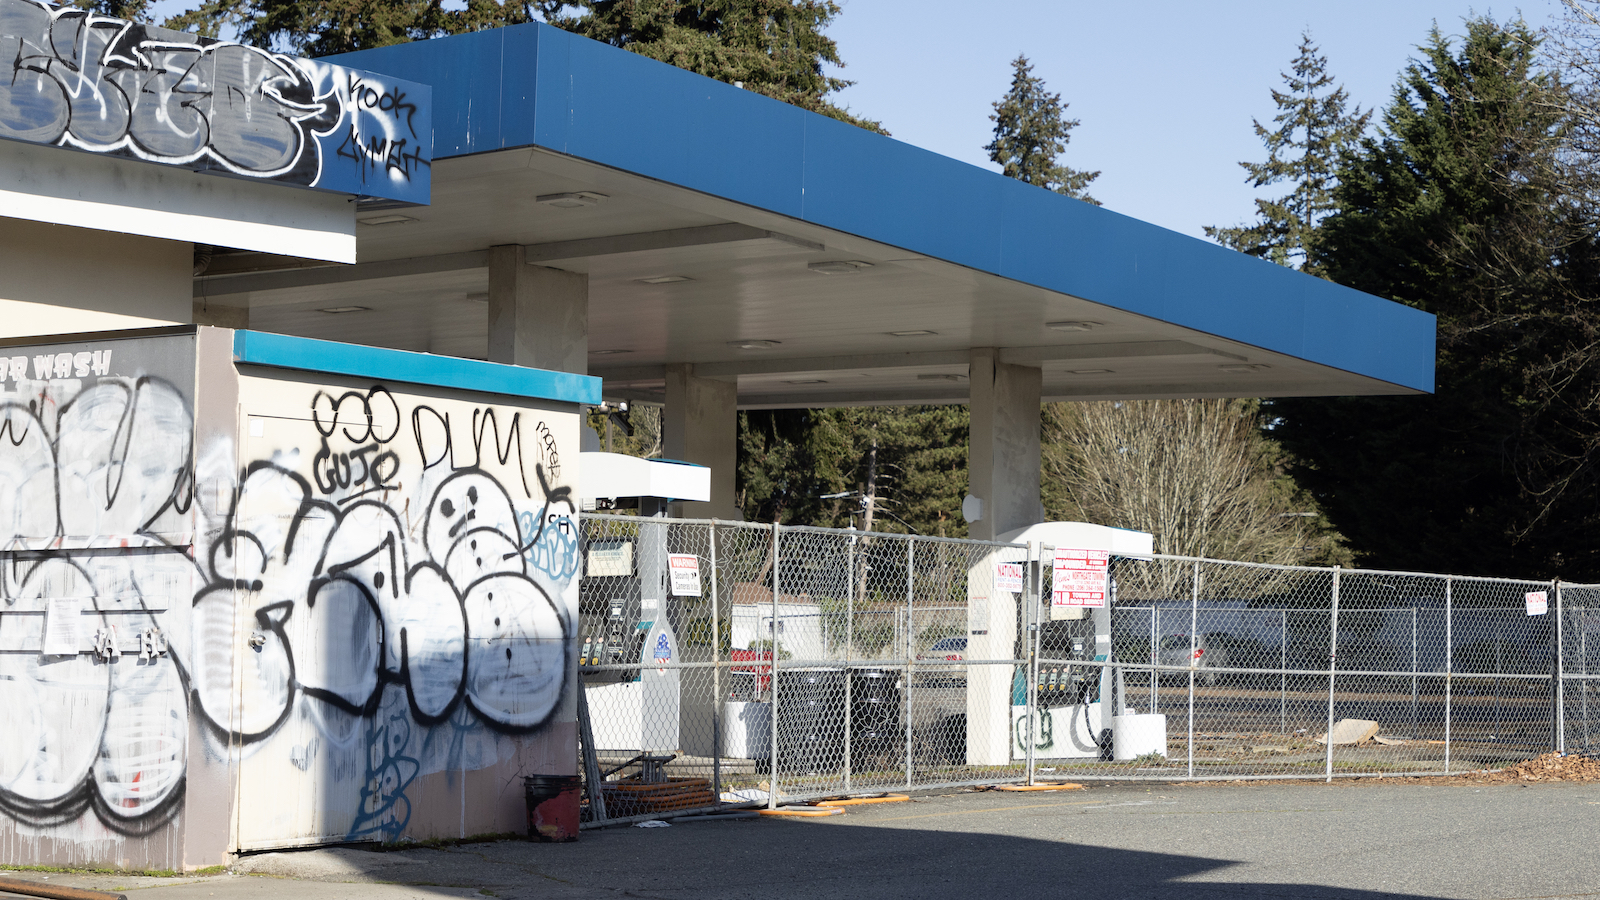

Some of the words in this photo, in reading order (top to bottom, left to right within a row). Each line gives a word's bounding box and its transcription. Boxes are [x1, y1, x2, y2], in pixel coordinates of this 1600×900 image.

[33, 350, 112, 380] WASH
[672, 558, 697, 568] WARNING
[674, 571, 690, 581] Security
[998, 565, 1021, 578] NATIONAL
[1072, 572, 1091, 580] NORTHGATE
[1092, 572, 1105, 581] TOWING
[676, 581, 690, 590] Cameras
[1054, 592, 1061, 604] 24
[1527, 592, 1546, 603] NATIONAL
